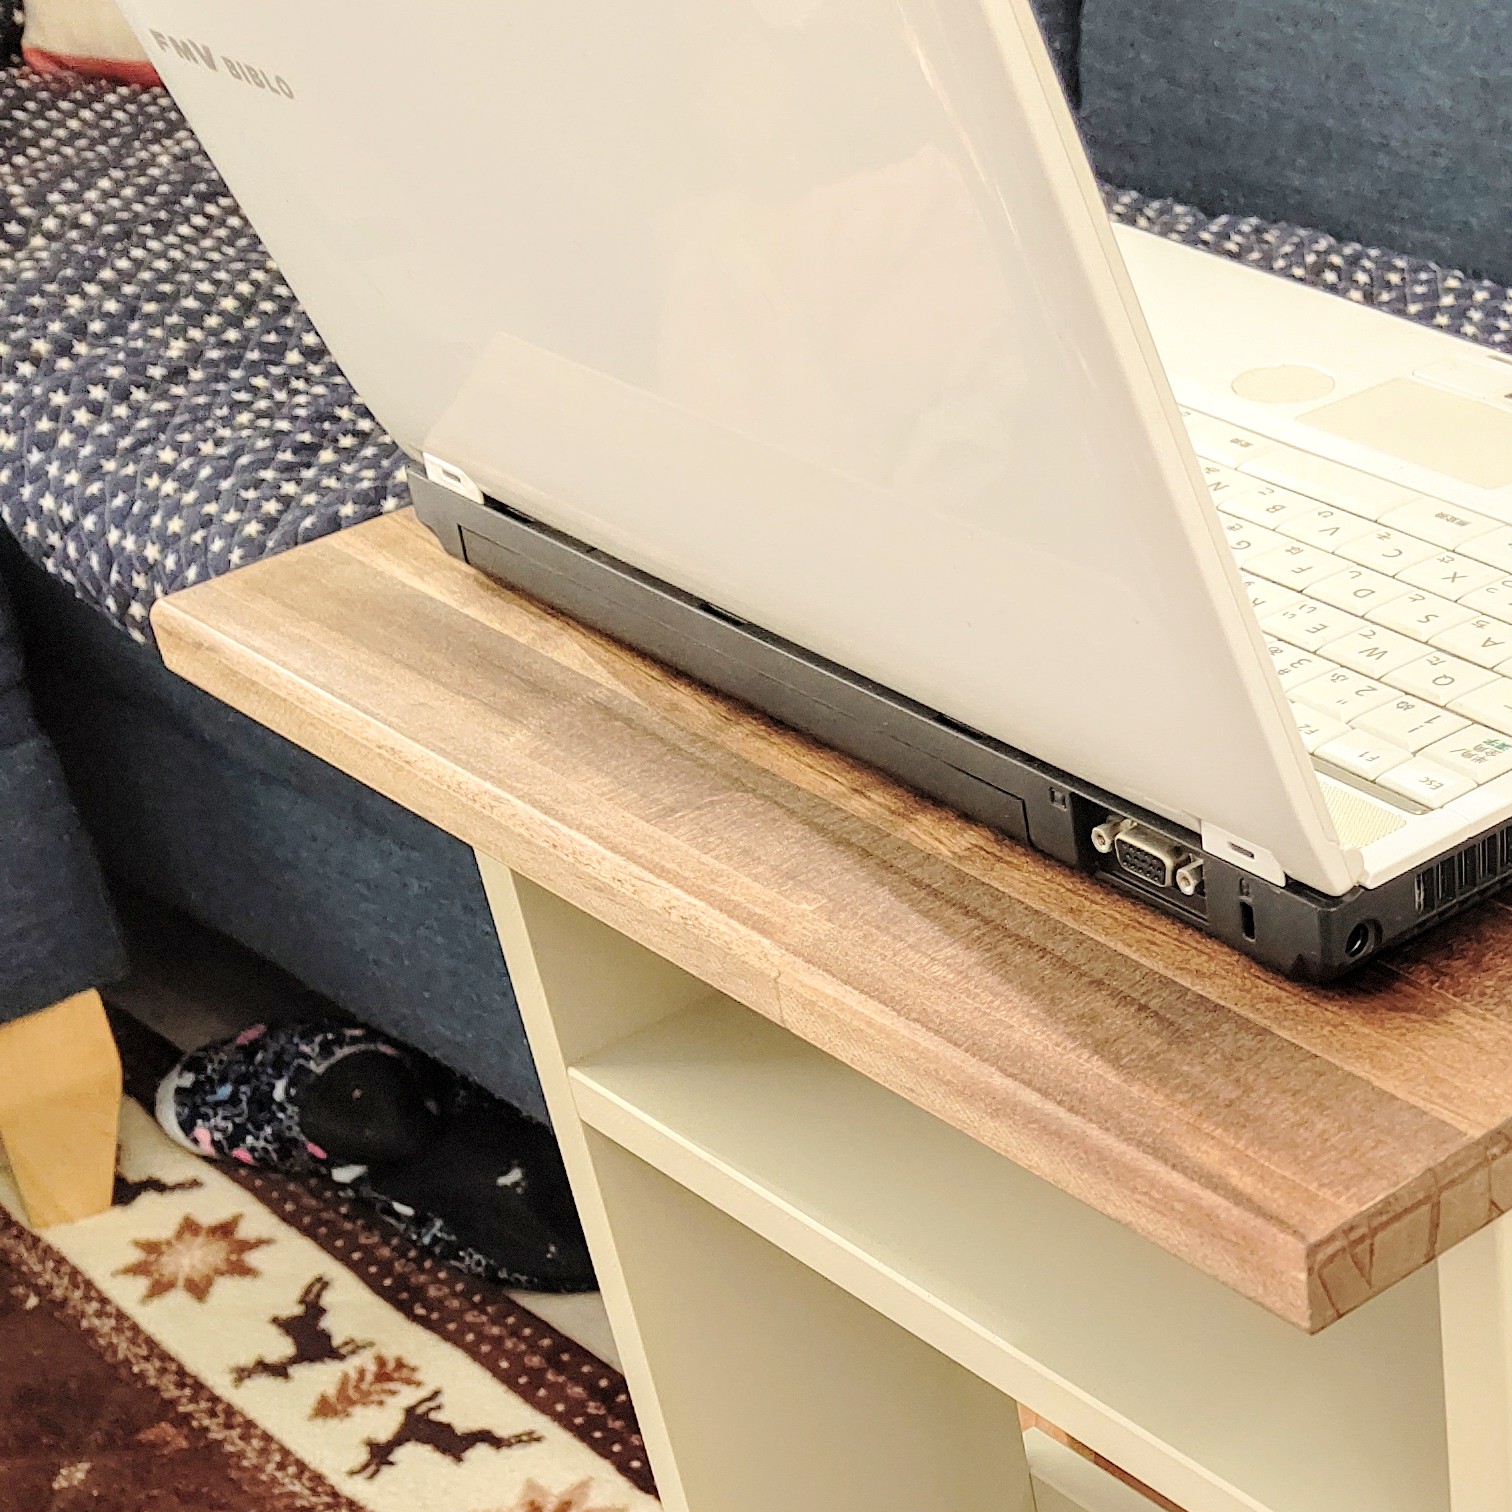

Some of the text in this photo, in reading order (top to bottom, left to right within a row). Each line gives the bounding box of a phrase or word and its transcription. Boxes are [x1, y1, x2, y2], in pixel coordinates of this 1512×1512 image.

[149, 28, 294, 99] FMV BIBLO
[1207, 480, 1231, 492] N
[1265, 504, 1287, 514] B
[1318, 526, 1341, 537] V
[1230, 539, 1252, 550] G
[1381, 548, 1404, 558] C
[1290, 565, 1314, 574] F
[1440, 571, 1469, 584] X
[1352, 588, 1377, 599] D
[1416, 613, 1440, 624] S
[1304, 623, 1329, 634] E
[1480, 636, 1506, 648] A
[1357, 646, 1389, 661] W
[1290, 658, 1313, 669] 3
[1431, 673, 1456, 687] Q
[1354, 685, 1379, 697] 2
[1426, 714, 1442, 725] 1
[1357, 750, 1381, 762] F1
[1418, 776, 1445, 791] Esc
